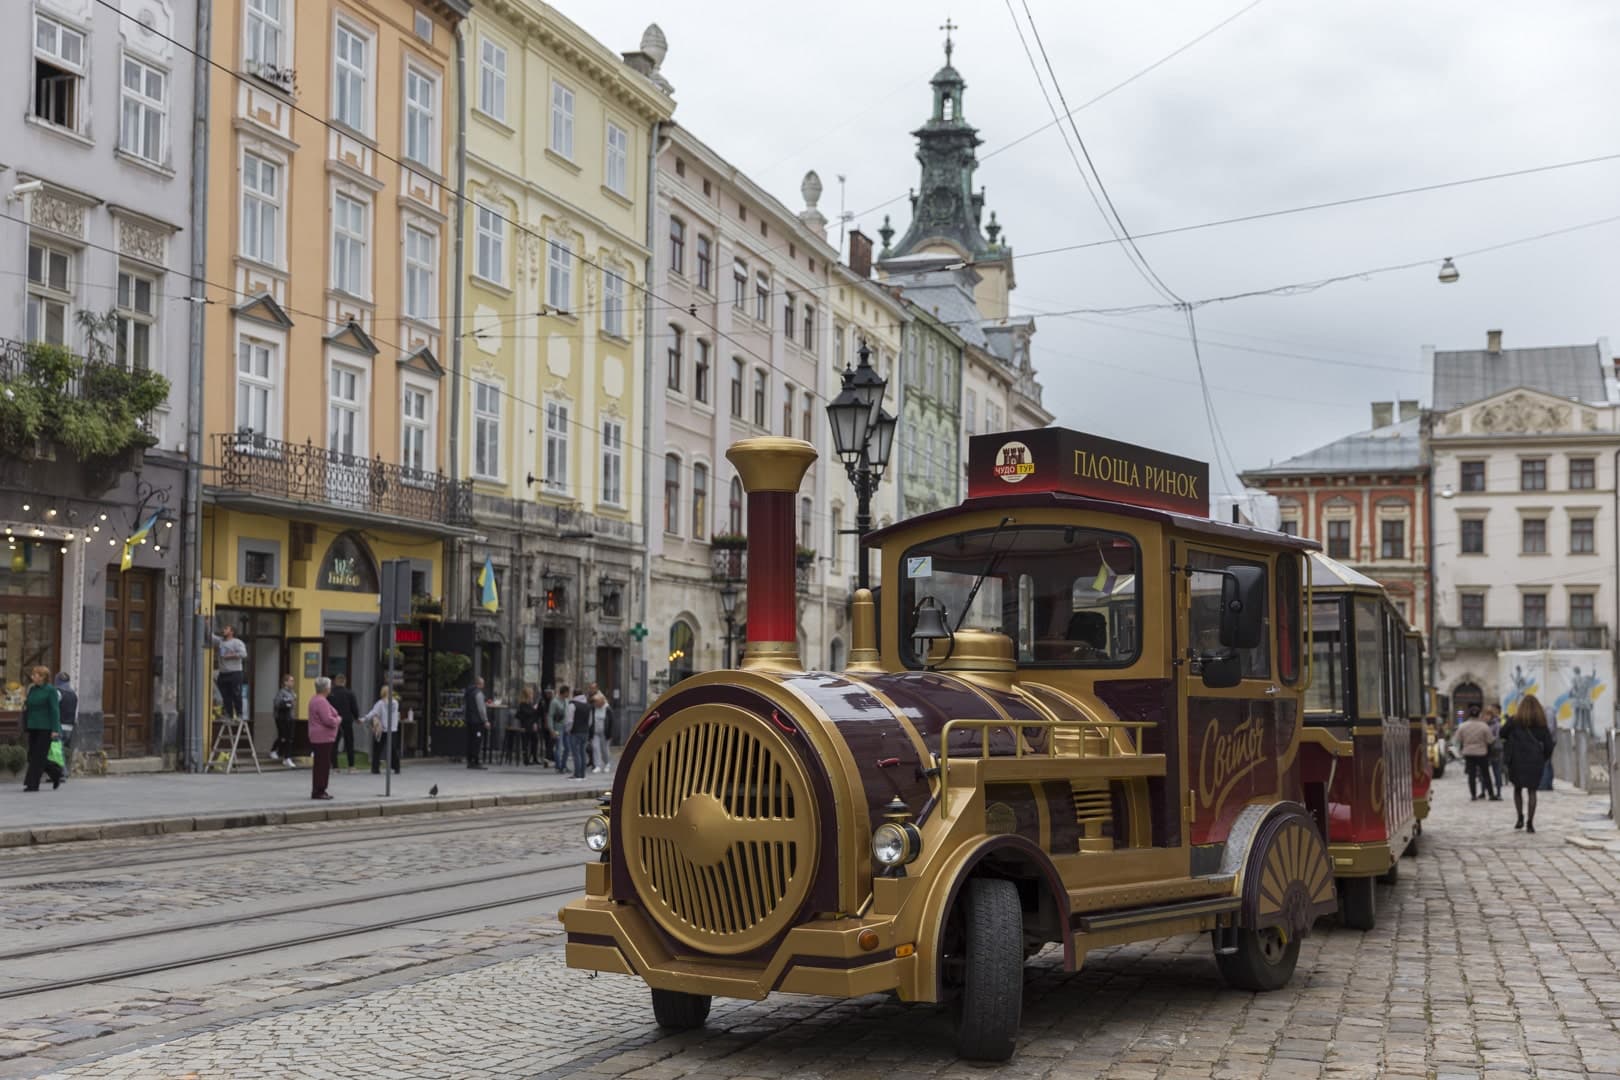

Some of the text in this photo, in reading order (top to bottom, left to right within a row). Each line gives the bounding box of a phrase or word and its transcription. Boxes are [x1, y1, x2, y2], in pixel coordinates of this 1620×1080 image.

[995, 464, 1033, 475] ЧУДО ТУР
[1074, 449, 1199, 499] ПЛОЩА РИНОК
